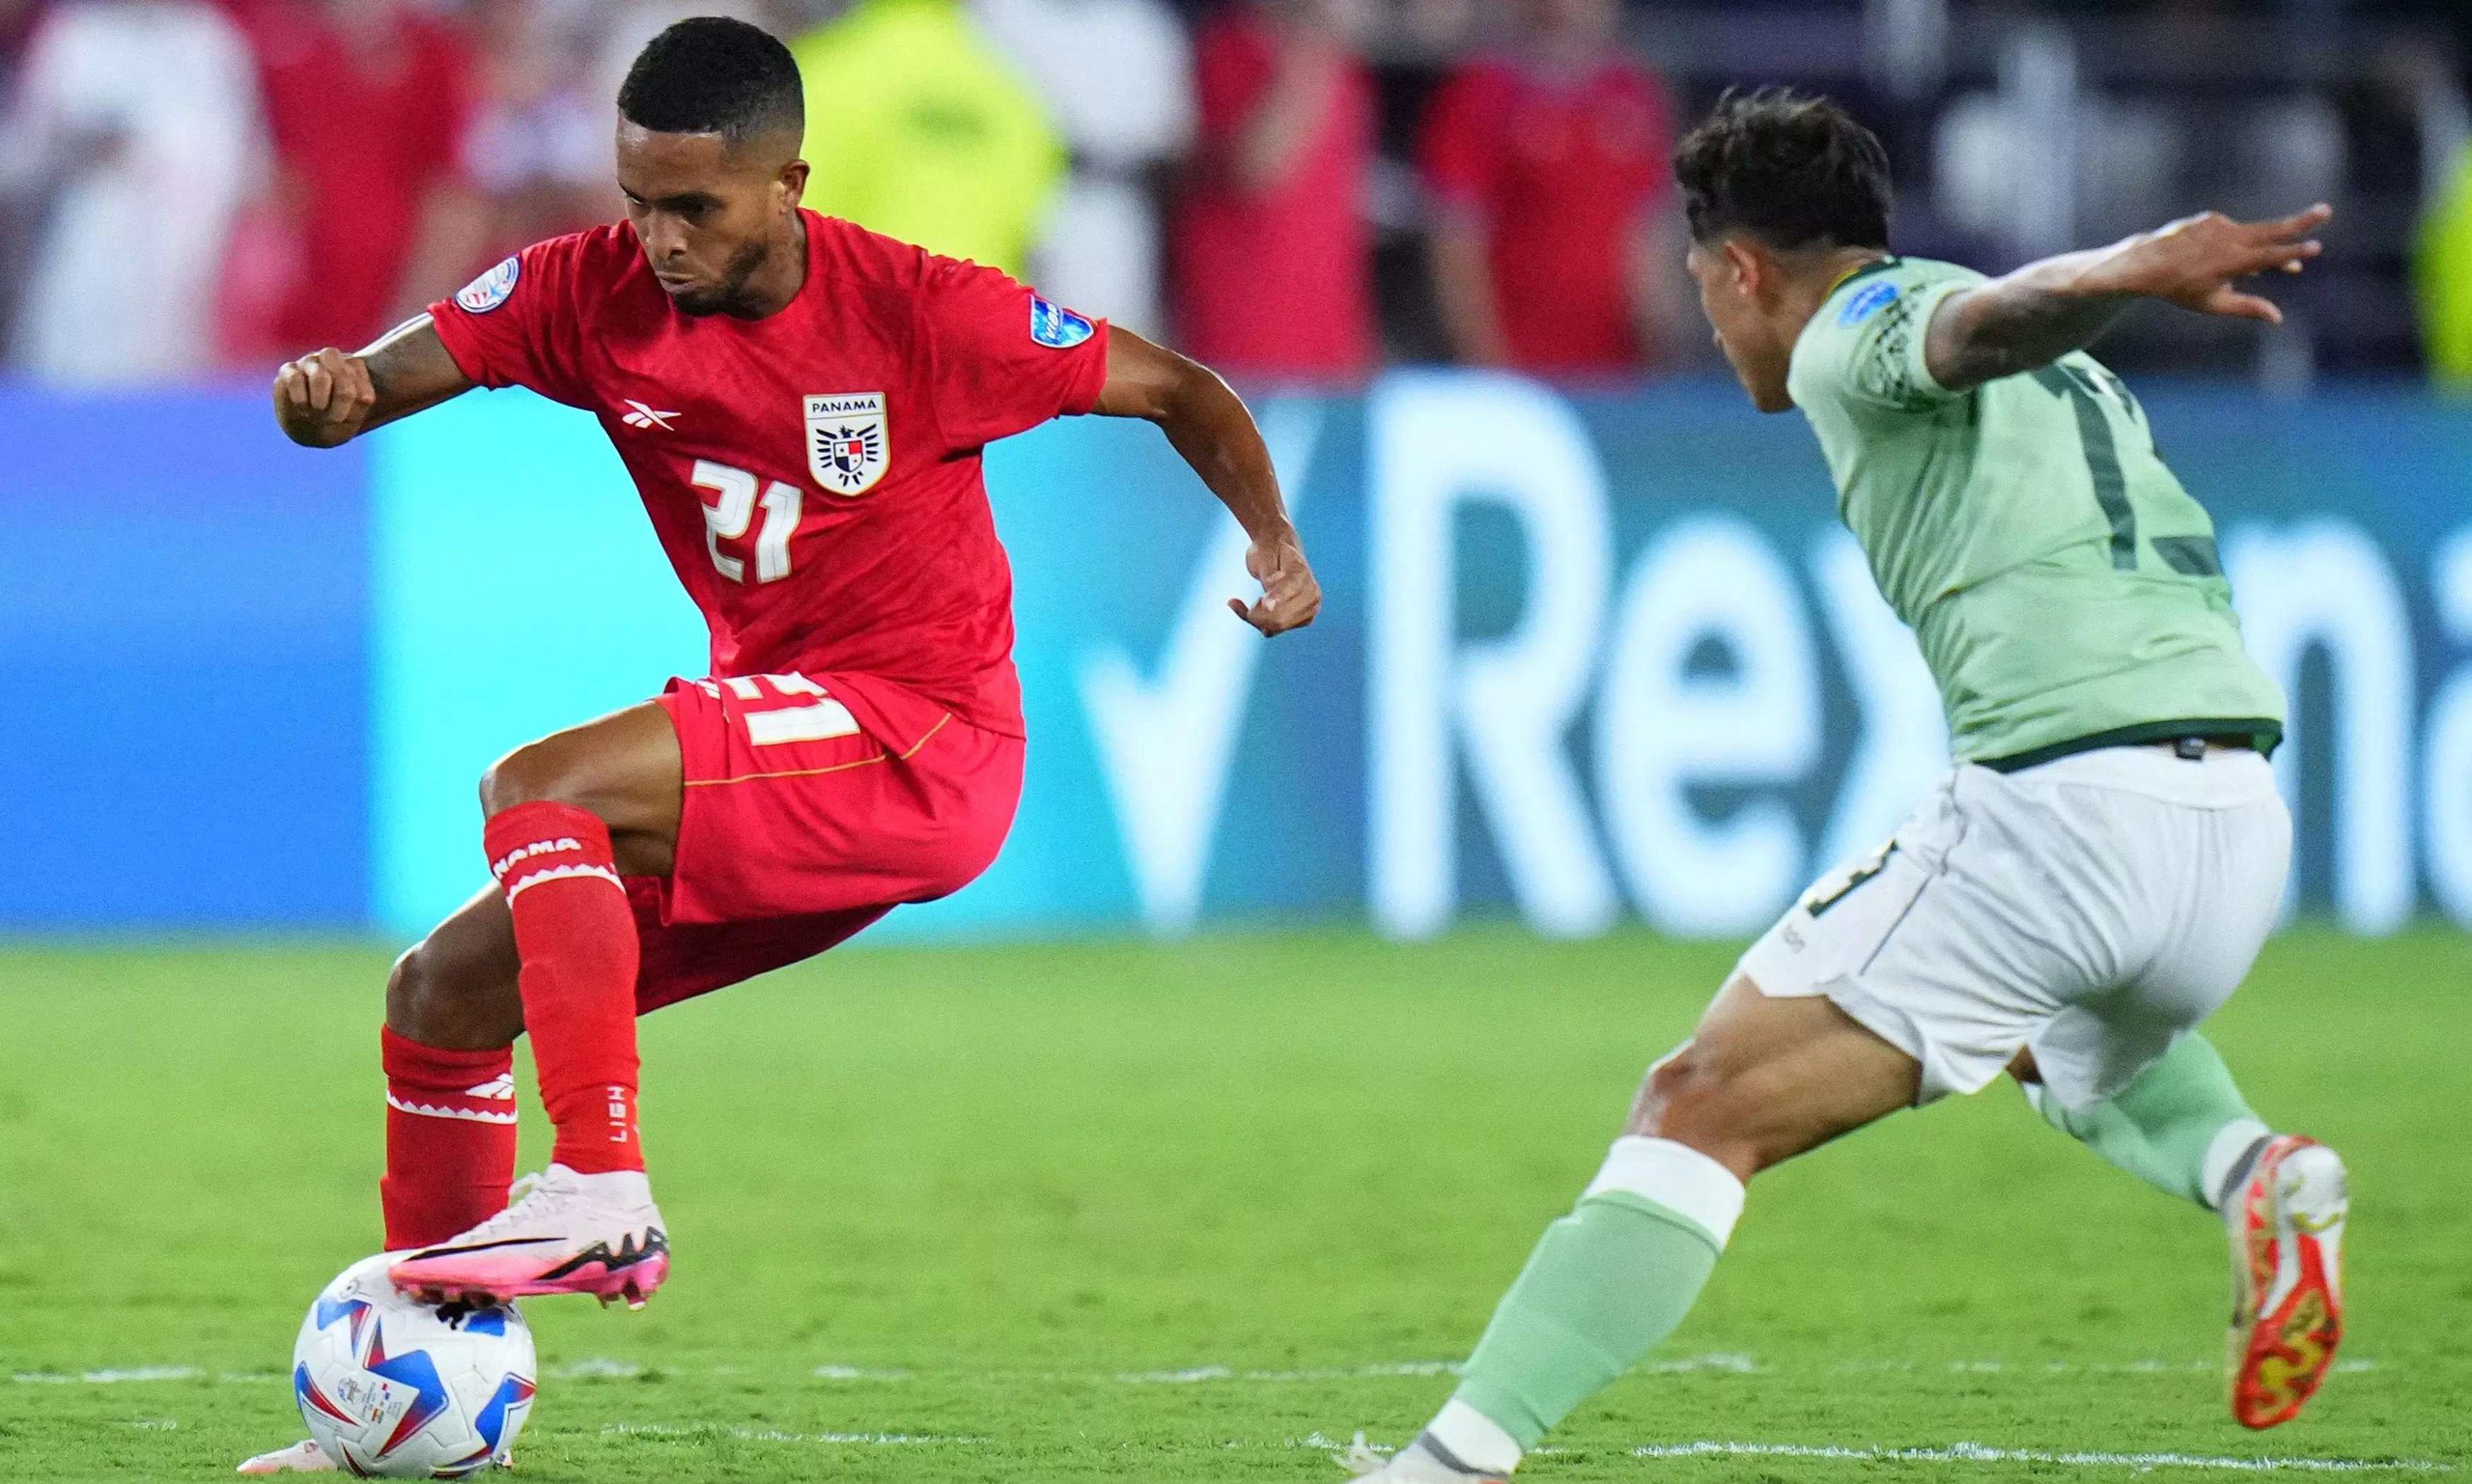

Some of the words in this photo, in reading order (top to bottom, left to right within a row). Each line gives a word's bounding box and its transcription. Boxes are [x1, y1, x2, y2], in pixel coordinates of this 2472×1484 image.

[812, 399, 877, 413] PANAMA
[690, 459, 803, 584] 21
[1369, 375, 2472, 942] Rexn
